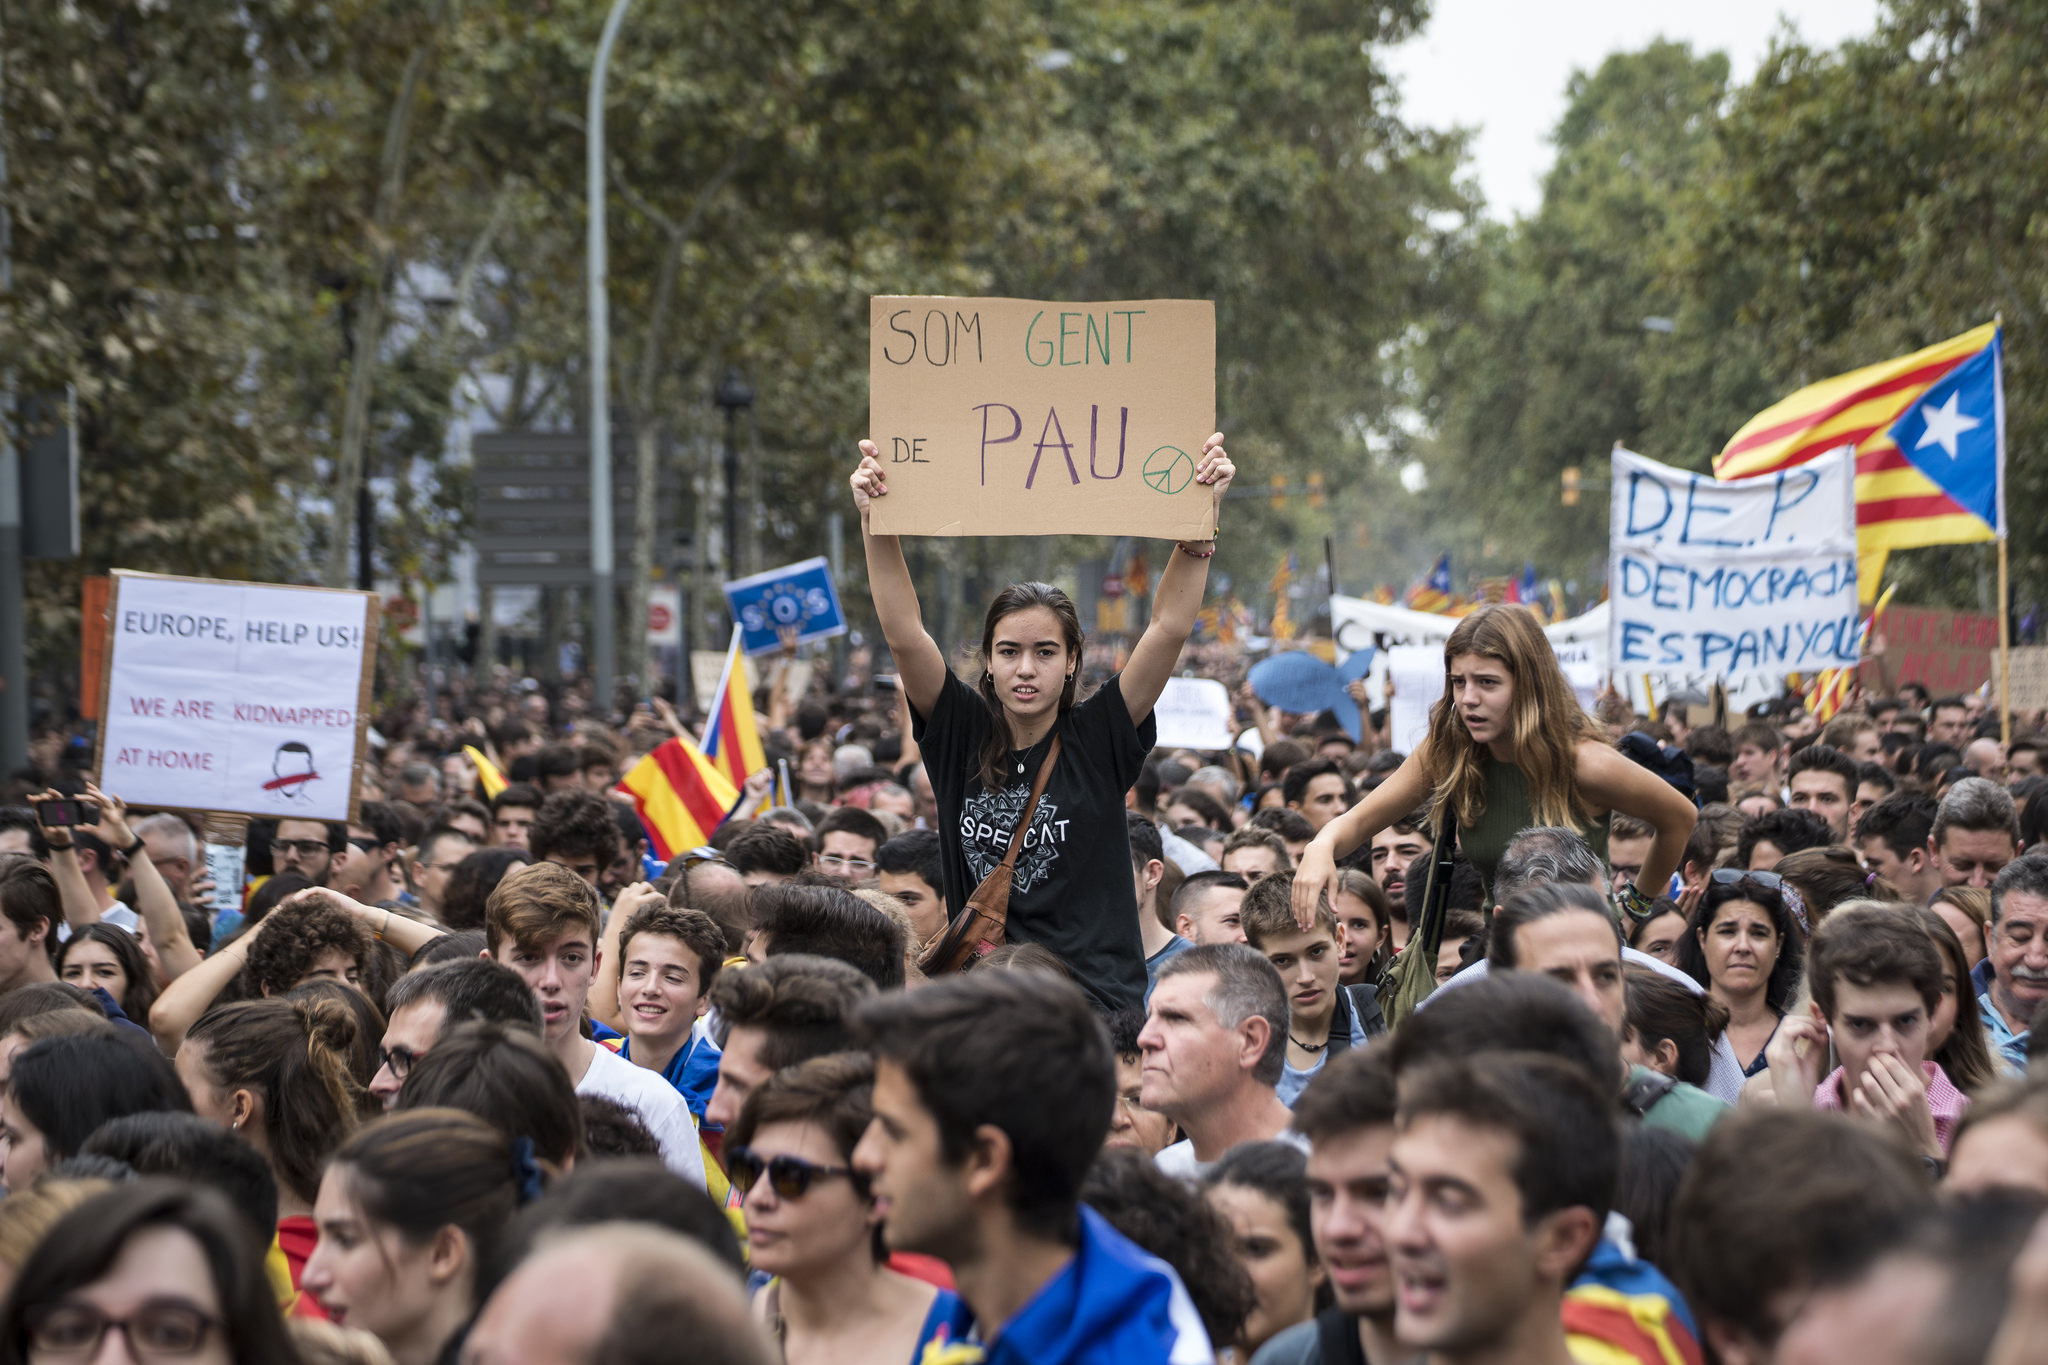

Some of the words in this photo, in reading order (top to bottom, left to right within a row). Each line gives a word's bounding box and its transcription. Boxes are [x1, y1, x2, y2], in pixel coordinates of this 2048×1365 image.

[884, 309, 982, 367] SOM
[1025, 310, 1146, 367] GENT
[891, 437, 930, 463] DE
[971, 403, 1128, 490] PAU
[1621, 556, 1858, 611] DEMOCRACIA
[123, 610, 235, 645] EUROPE,
[245, 619, 309, 646] HELP
[316, 624, 360, 649] US!
[130, 696, 167, 718] WE
[171, 699, 215, 720] ARE
[233, 703, 352, 728] KIDNAPPED
[116, 747, 142, 766] AT
[147, 749, 214, 771] HOME
